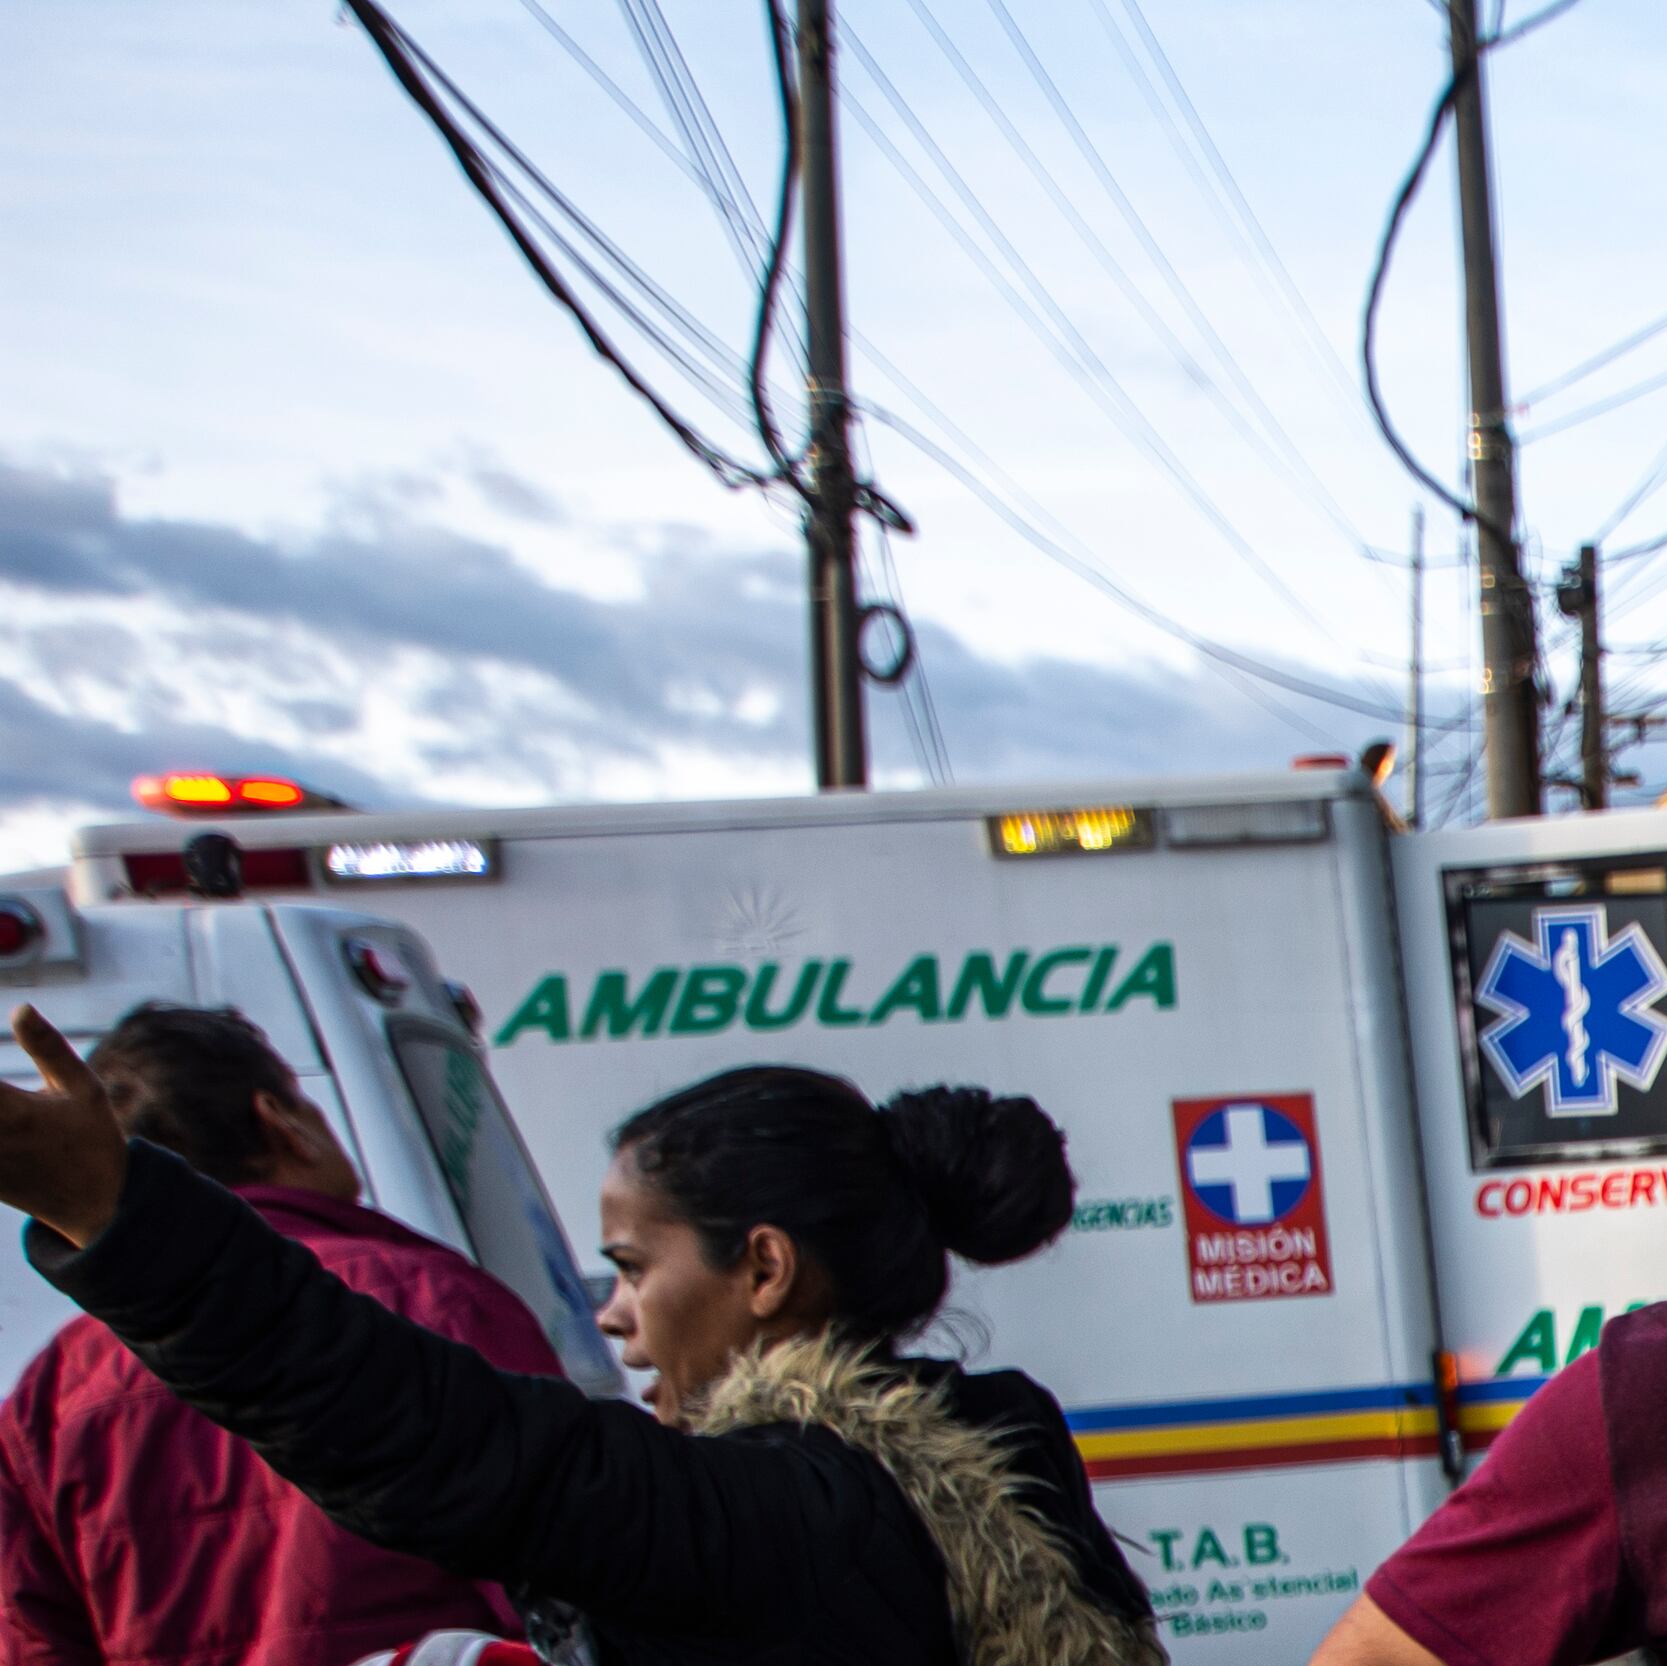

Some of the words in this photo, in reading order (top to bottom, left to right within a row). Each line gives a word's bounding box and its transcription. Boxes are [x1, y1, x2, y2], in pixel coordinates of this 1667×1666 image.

[494, 939, 1178, 1047] AMBULANCIA
[1196, 1223, 1317, 1265] MISIÓN
[1194, 1260, 1329, 1298] MÉDICA
